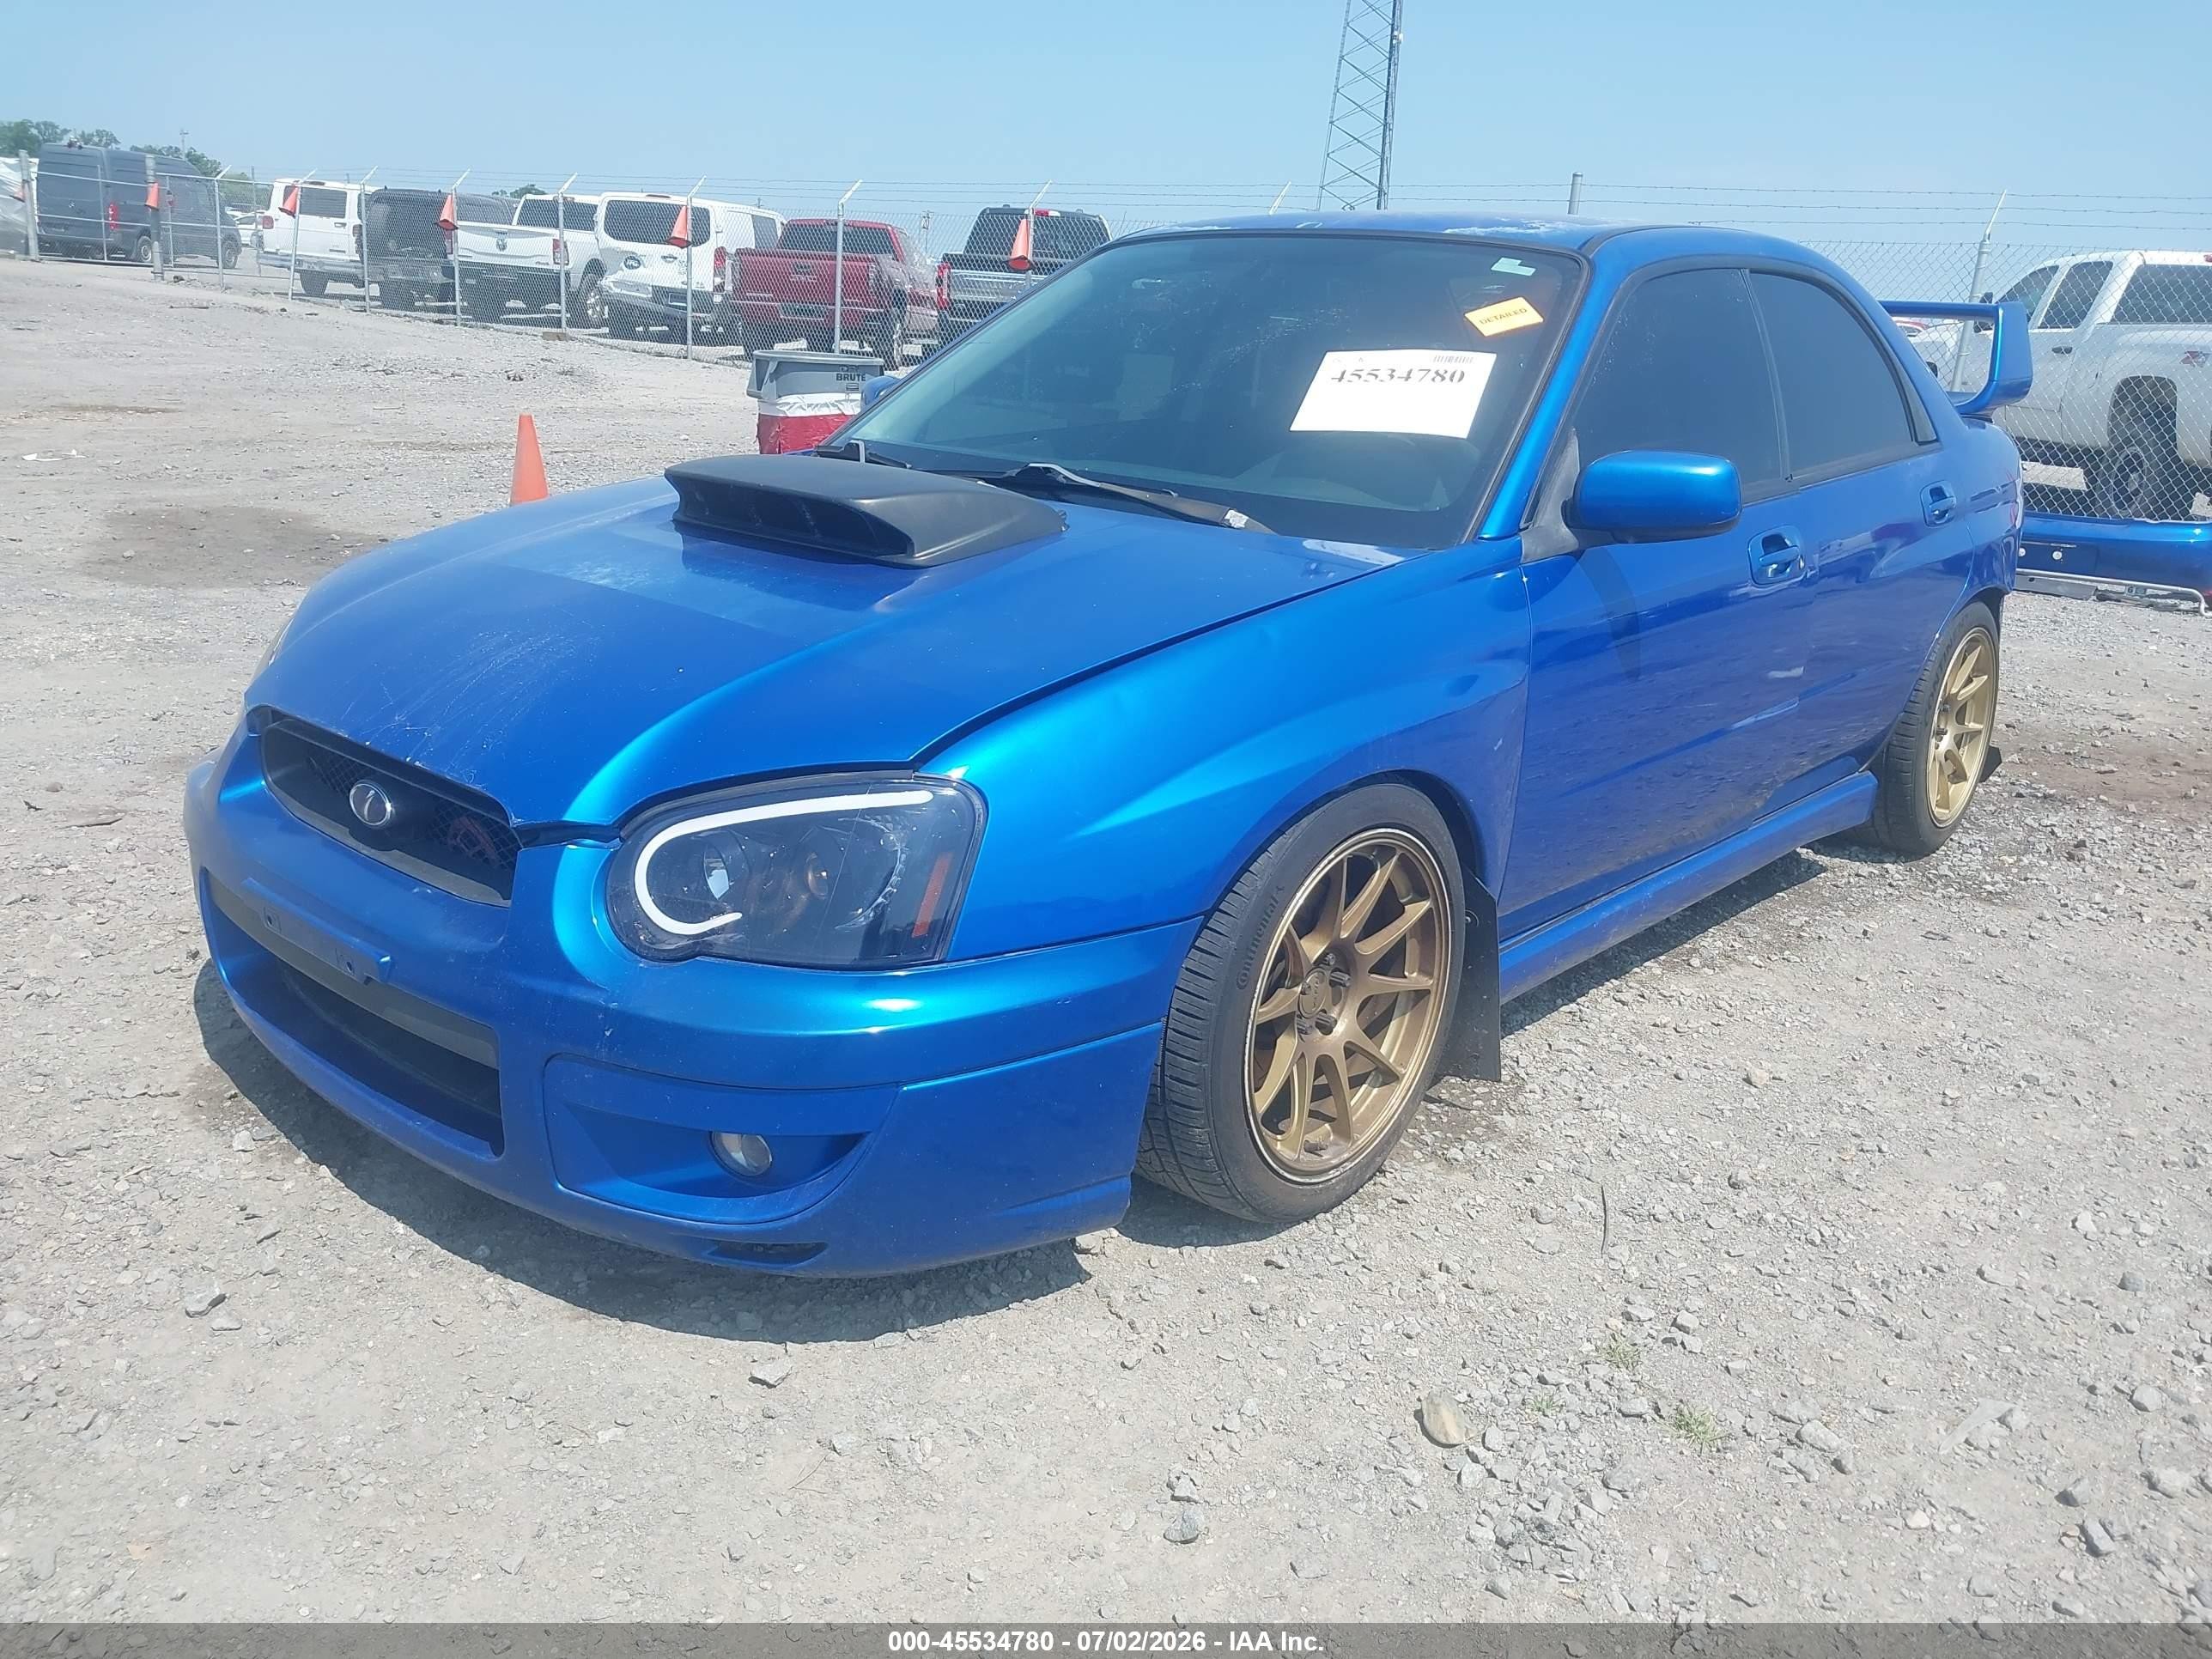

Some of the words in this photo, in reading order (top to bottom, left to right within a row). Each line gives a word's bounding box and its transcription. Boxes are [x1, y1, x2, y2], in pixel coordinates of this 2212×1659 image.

[1479, 307, 1528, 325] DETAILED
[836, 373, 866, 382] BRUTE
[1330, 368, 1466, 383] 45534780
